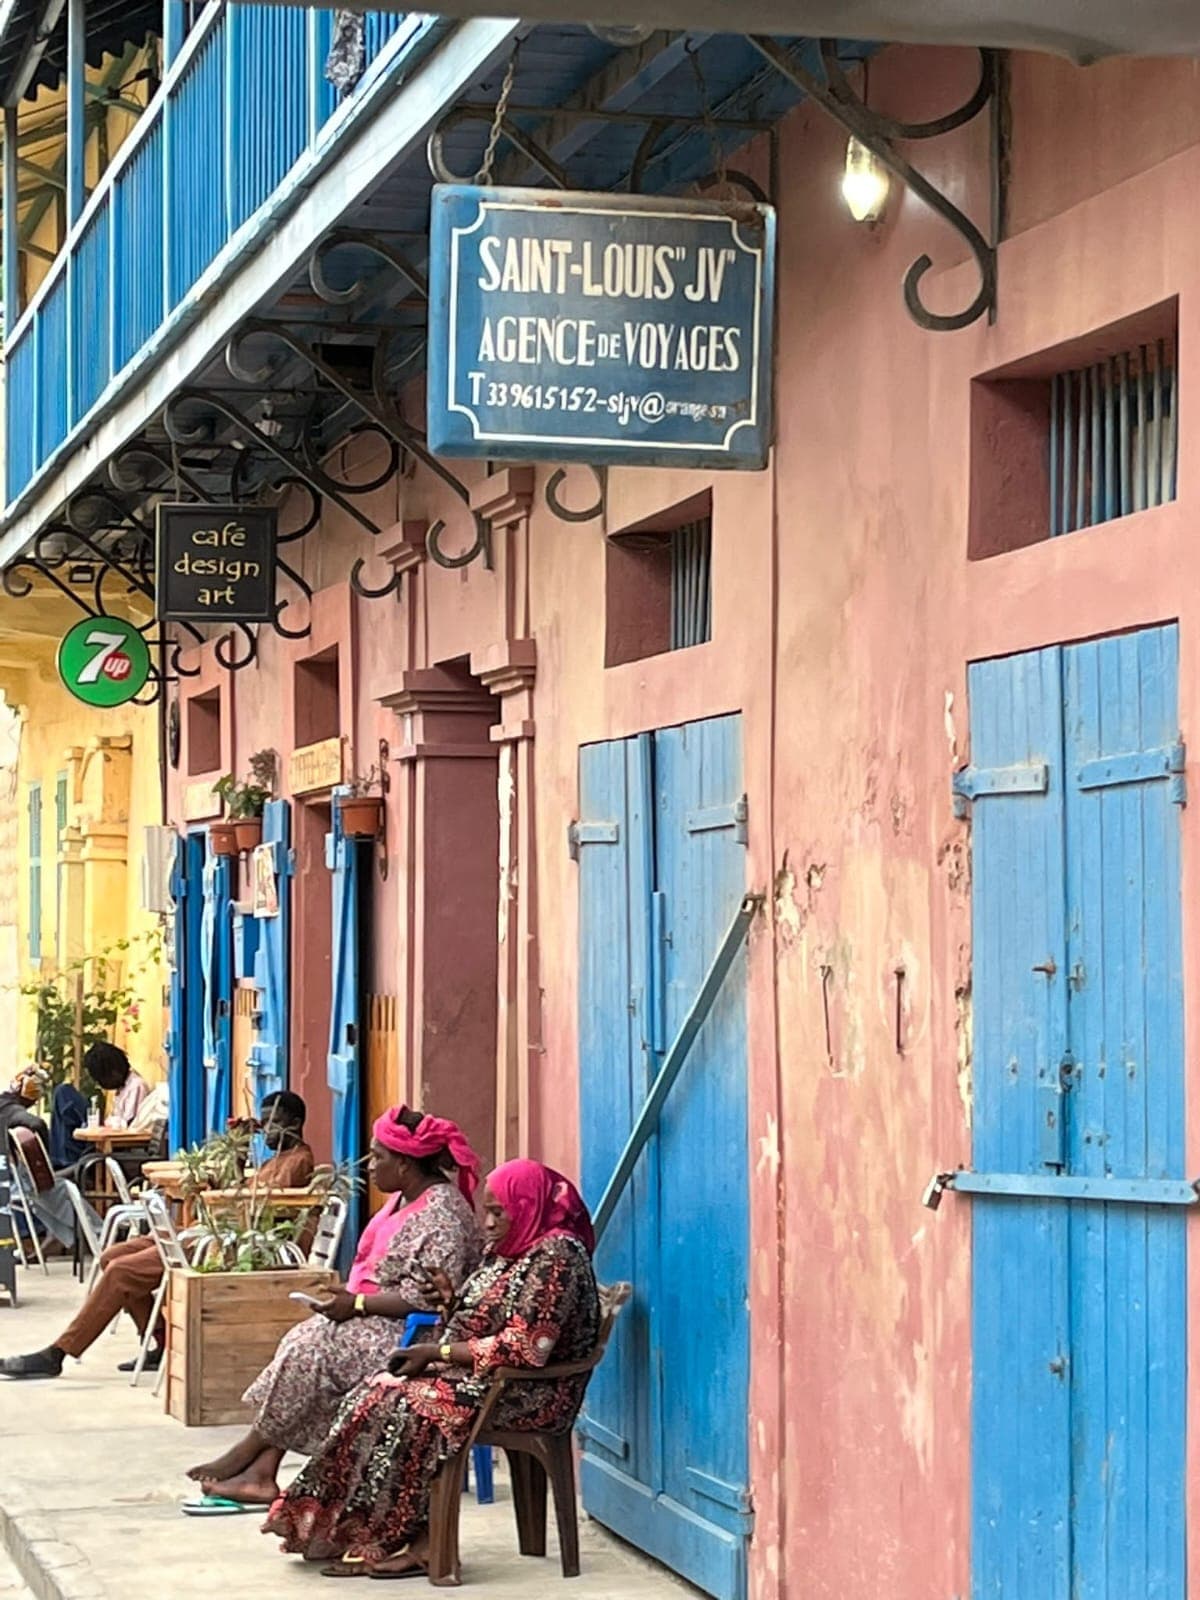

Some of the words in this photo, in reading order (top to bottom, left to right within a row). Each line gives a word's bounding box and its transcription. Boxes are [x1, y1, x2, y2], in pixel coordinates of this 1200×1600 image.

[478, 316, 596, 366] AGENCE
[597, 333, 621, 360] DE
[624, 322, 741, 372] VOYAGES
[468, 371, 486, 406] T
[191, 522, 247, 547] café
[174, 552, 260, 581] design
[197, 586, 235, 606] art
